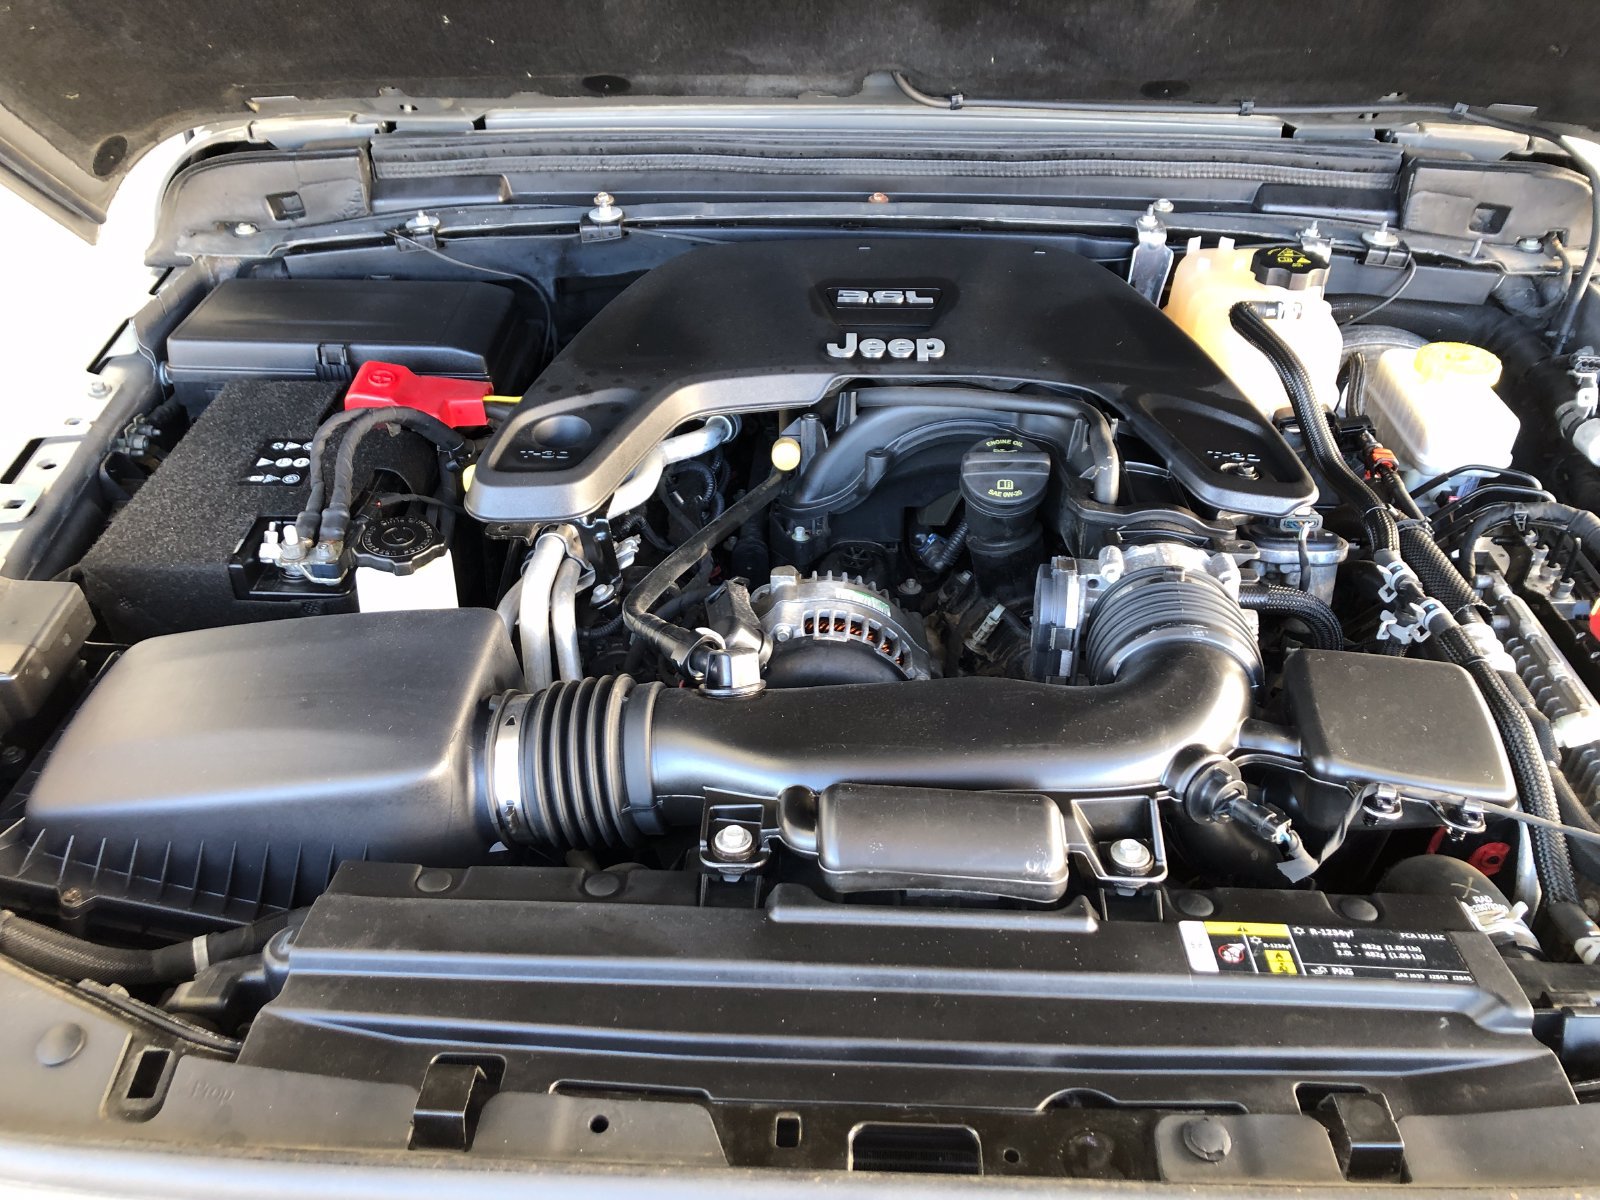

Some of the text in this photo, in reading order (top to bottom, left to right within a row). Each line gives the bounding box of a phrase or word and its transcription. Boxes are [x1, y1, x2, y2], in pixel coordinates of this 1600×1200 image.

[837, 289, 934, 304] 3.6L
[826, 332, 946, 362] Jeep
[986, 439, 1024, 448] ENGINE OIL
[988, 489, 1023, 498] SAE 0W-20
[1472, 895, 1493, 904] RAD
[1309, 927, 1355, 939] R-1234yf
[1400, 932, 1418, 940] FCA
[1332, 941, 1352, 949] 3.6L
[1336, 949, 1355, 957] 2.0L
[1331, 966, 1355, 976] PAG
